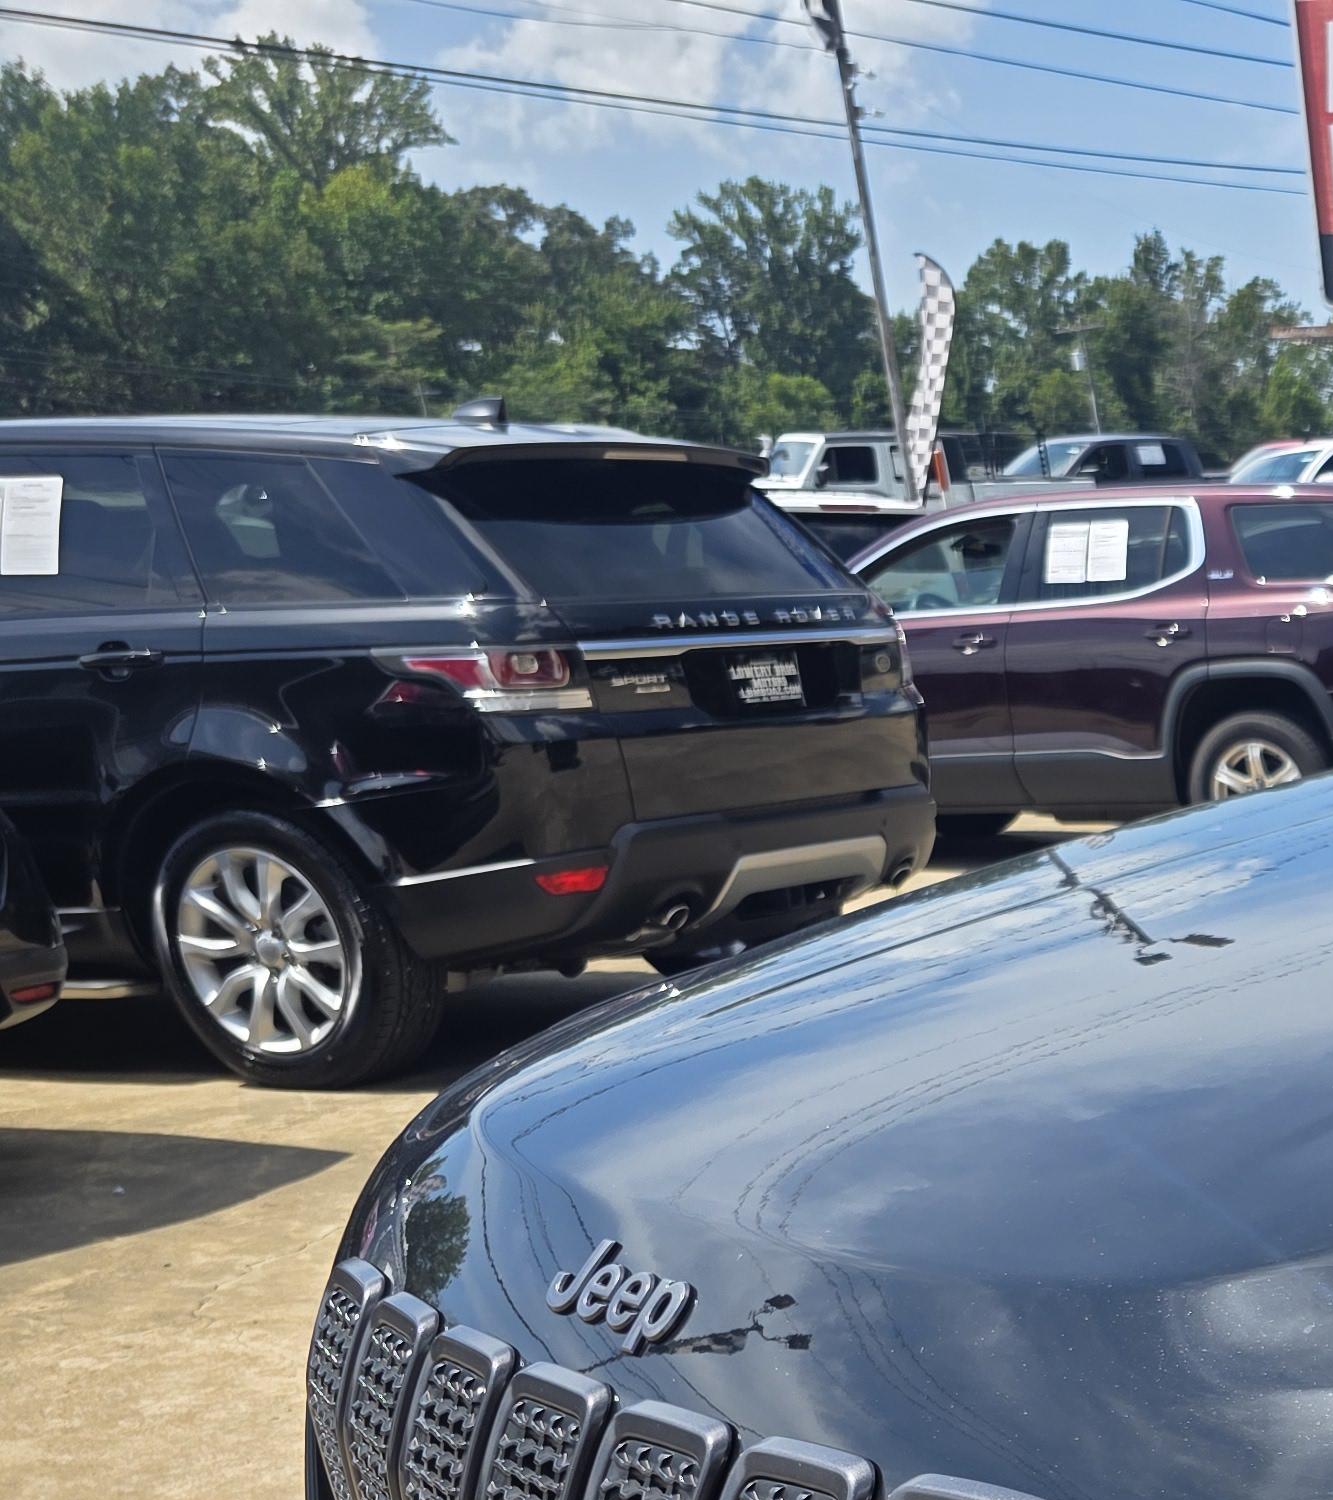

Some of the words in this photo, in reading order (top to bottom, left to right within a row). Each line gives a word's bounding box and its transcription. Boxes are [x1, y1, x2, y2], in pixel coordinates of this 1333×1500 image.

[651, 610, 760, 629] RANGE
[774, 604, 856, 624] ROVER
[610, 674, 668, 687] SPORT
[546, 1238, 698, 1357] Jeep
